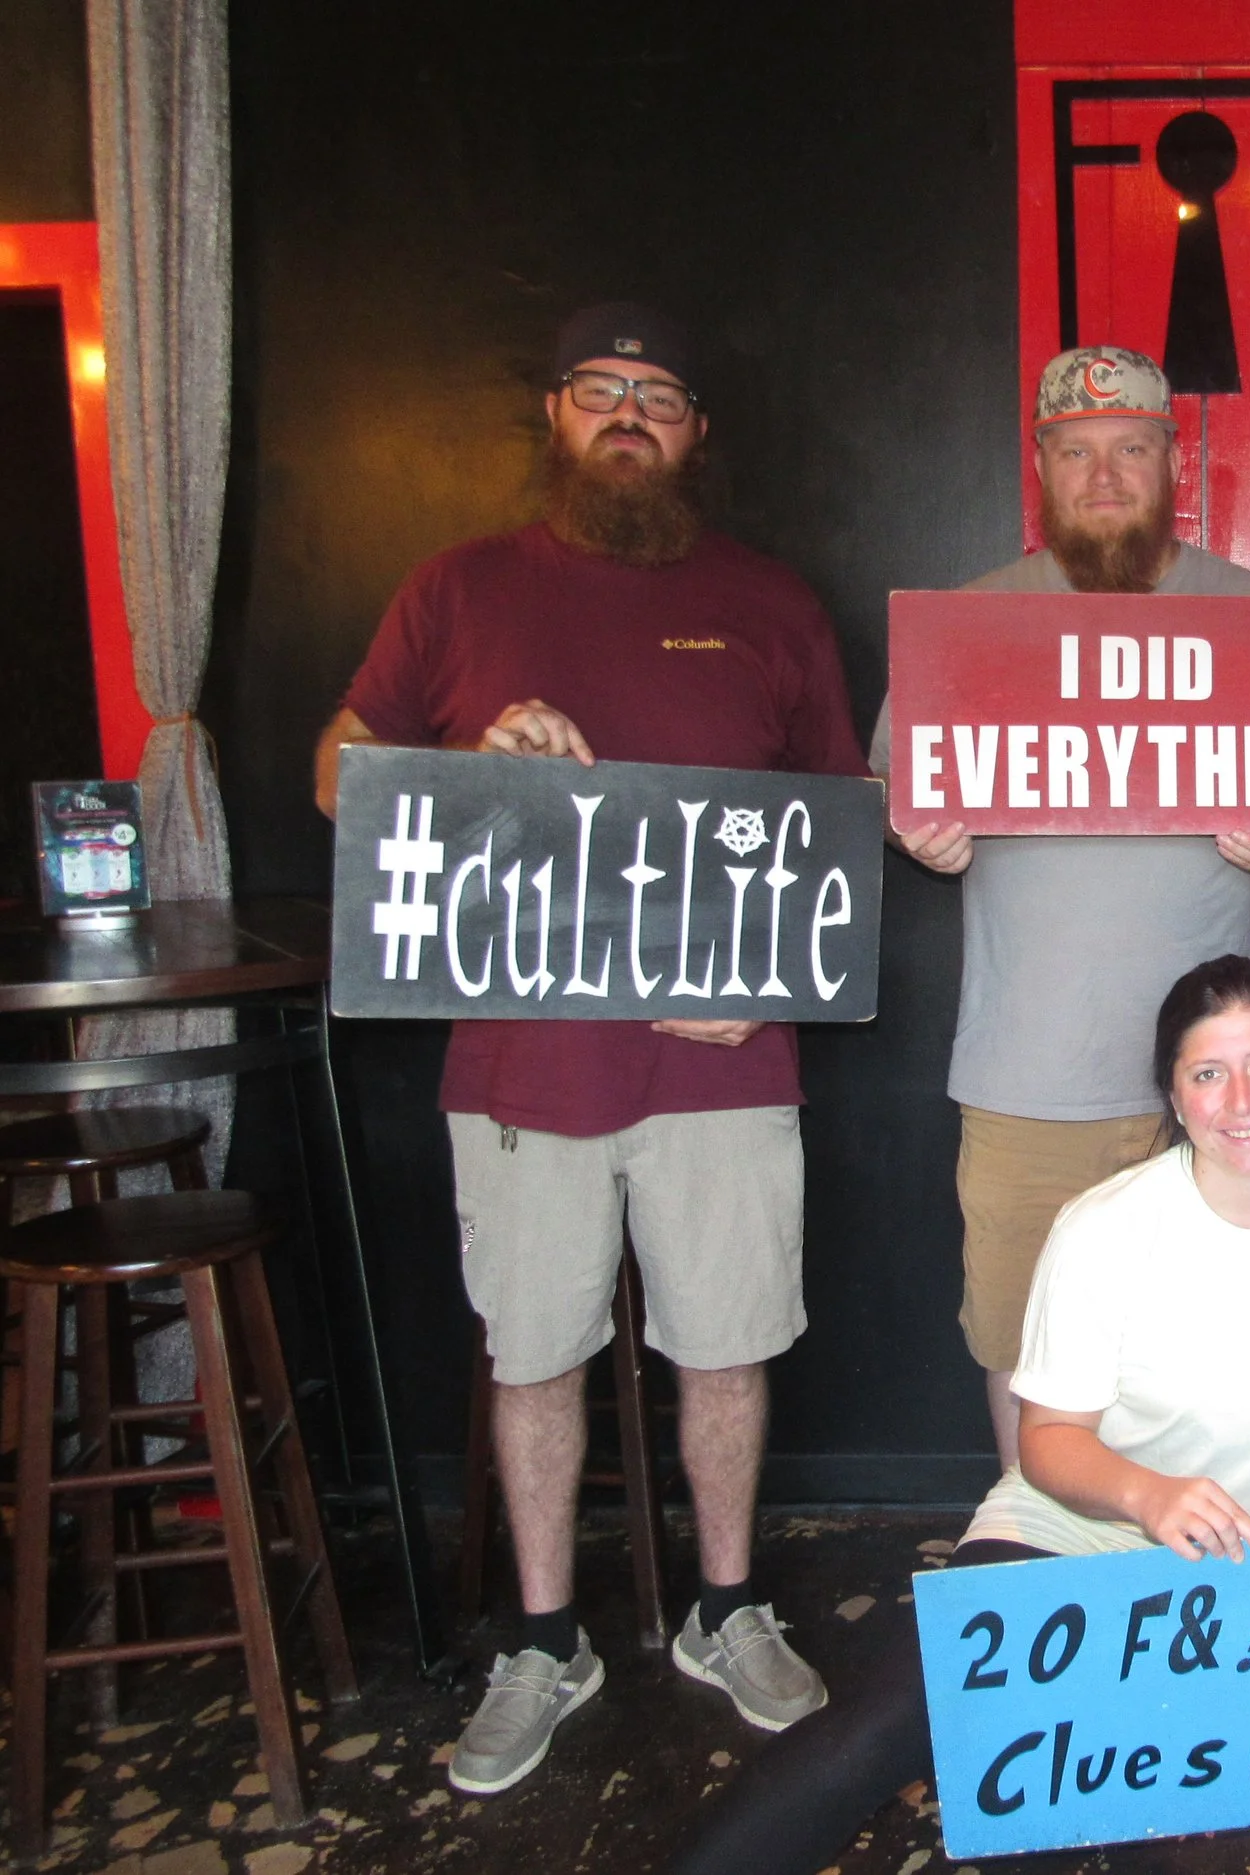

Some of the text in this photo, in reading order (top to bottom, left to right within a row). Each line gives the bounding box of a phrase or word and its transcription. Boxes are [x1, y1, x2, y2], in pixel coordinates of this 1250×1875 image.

[1084, 358, 1121, 401] C
[675, 638, 726, 649] Columbia
[1060, 634, 1214, 701] I DID
[959, 1602, 1087, 1692] 20
[976, 1720, 1229, 1816] Clues
